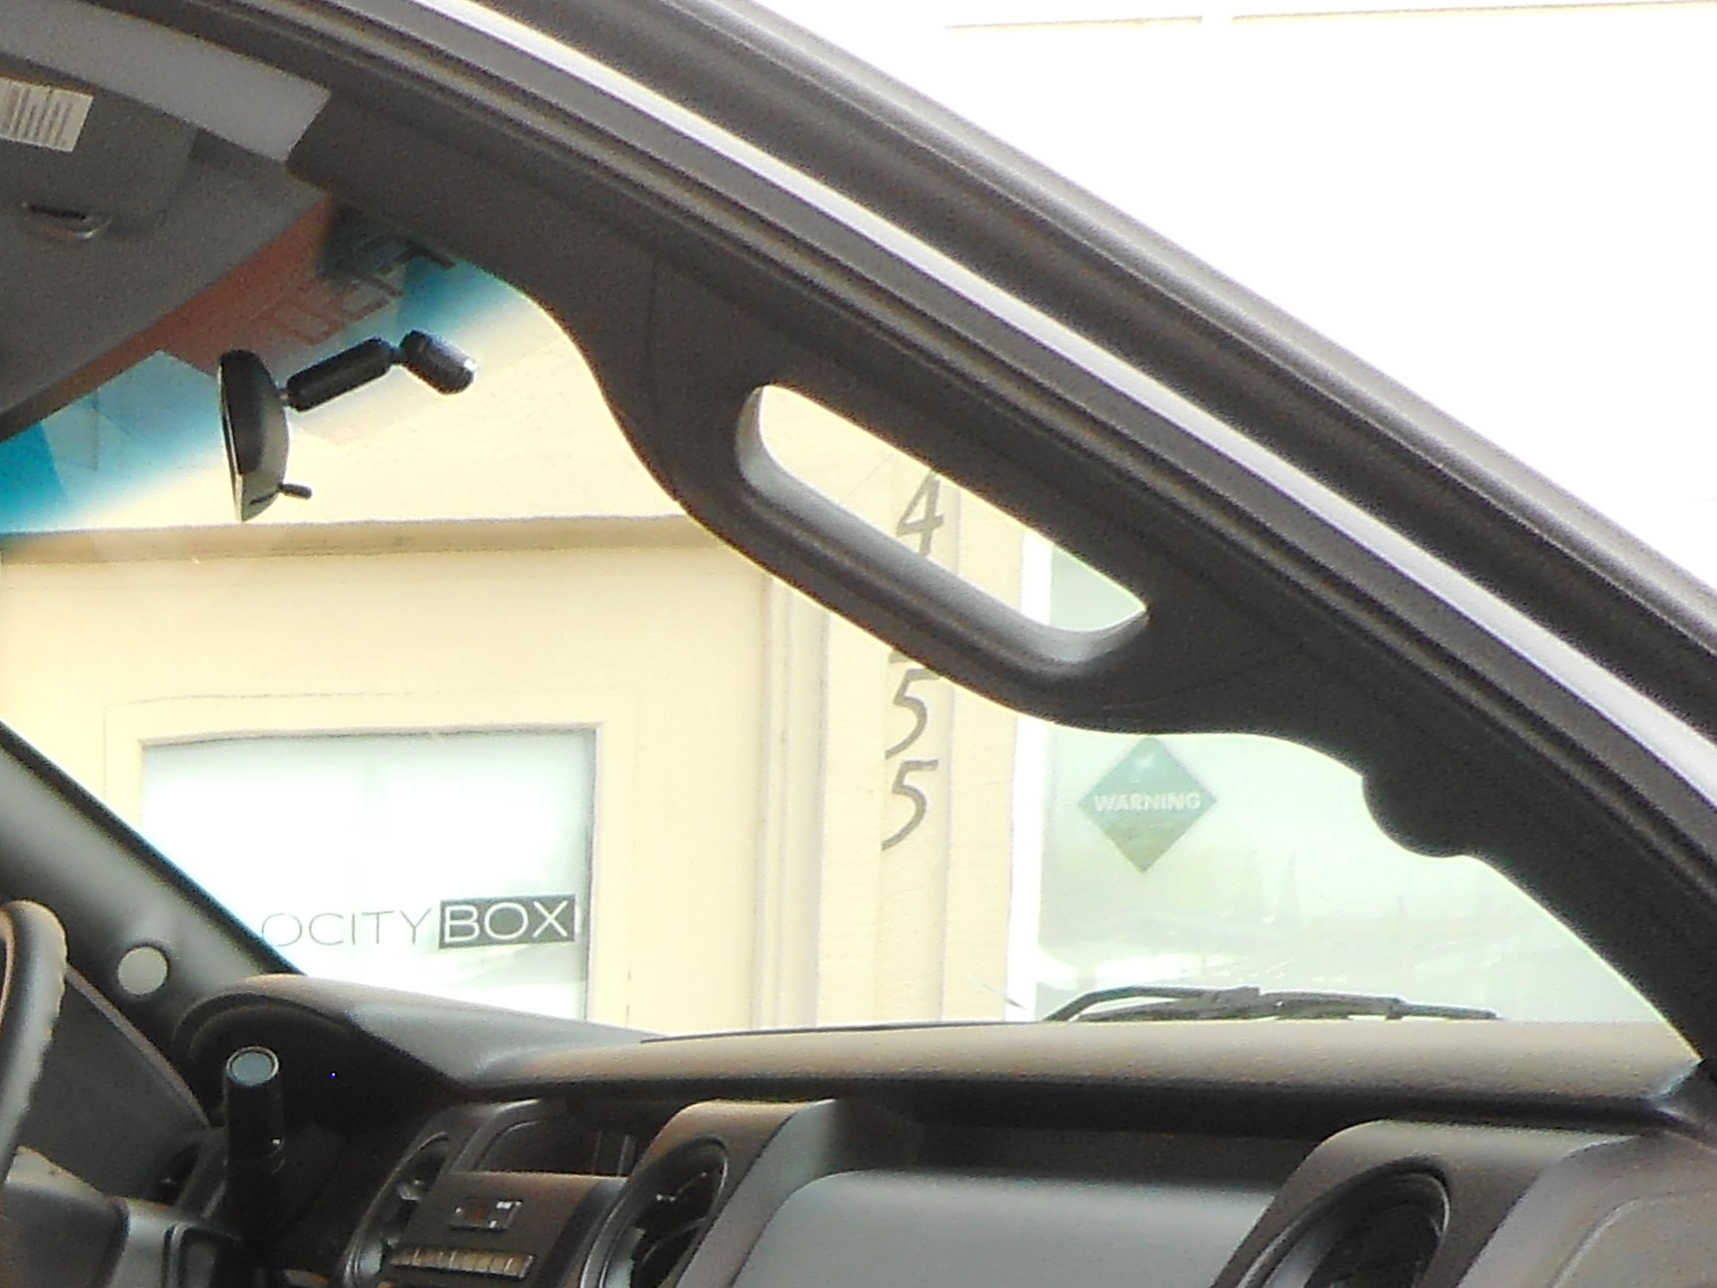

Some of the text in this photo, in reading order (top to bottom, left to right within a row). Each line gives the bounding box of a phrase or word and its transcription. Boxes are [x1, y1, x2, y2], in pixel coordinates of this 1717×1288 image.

[879, 470, 943, 851] 455
[1094, 792, 1201, 812] WARNING
[444, 900, 569, 942] BOX
